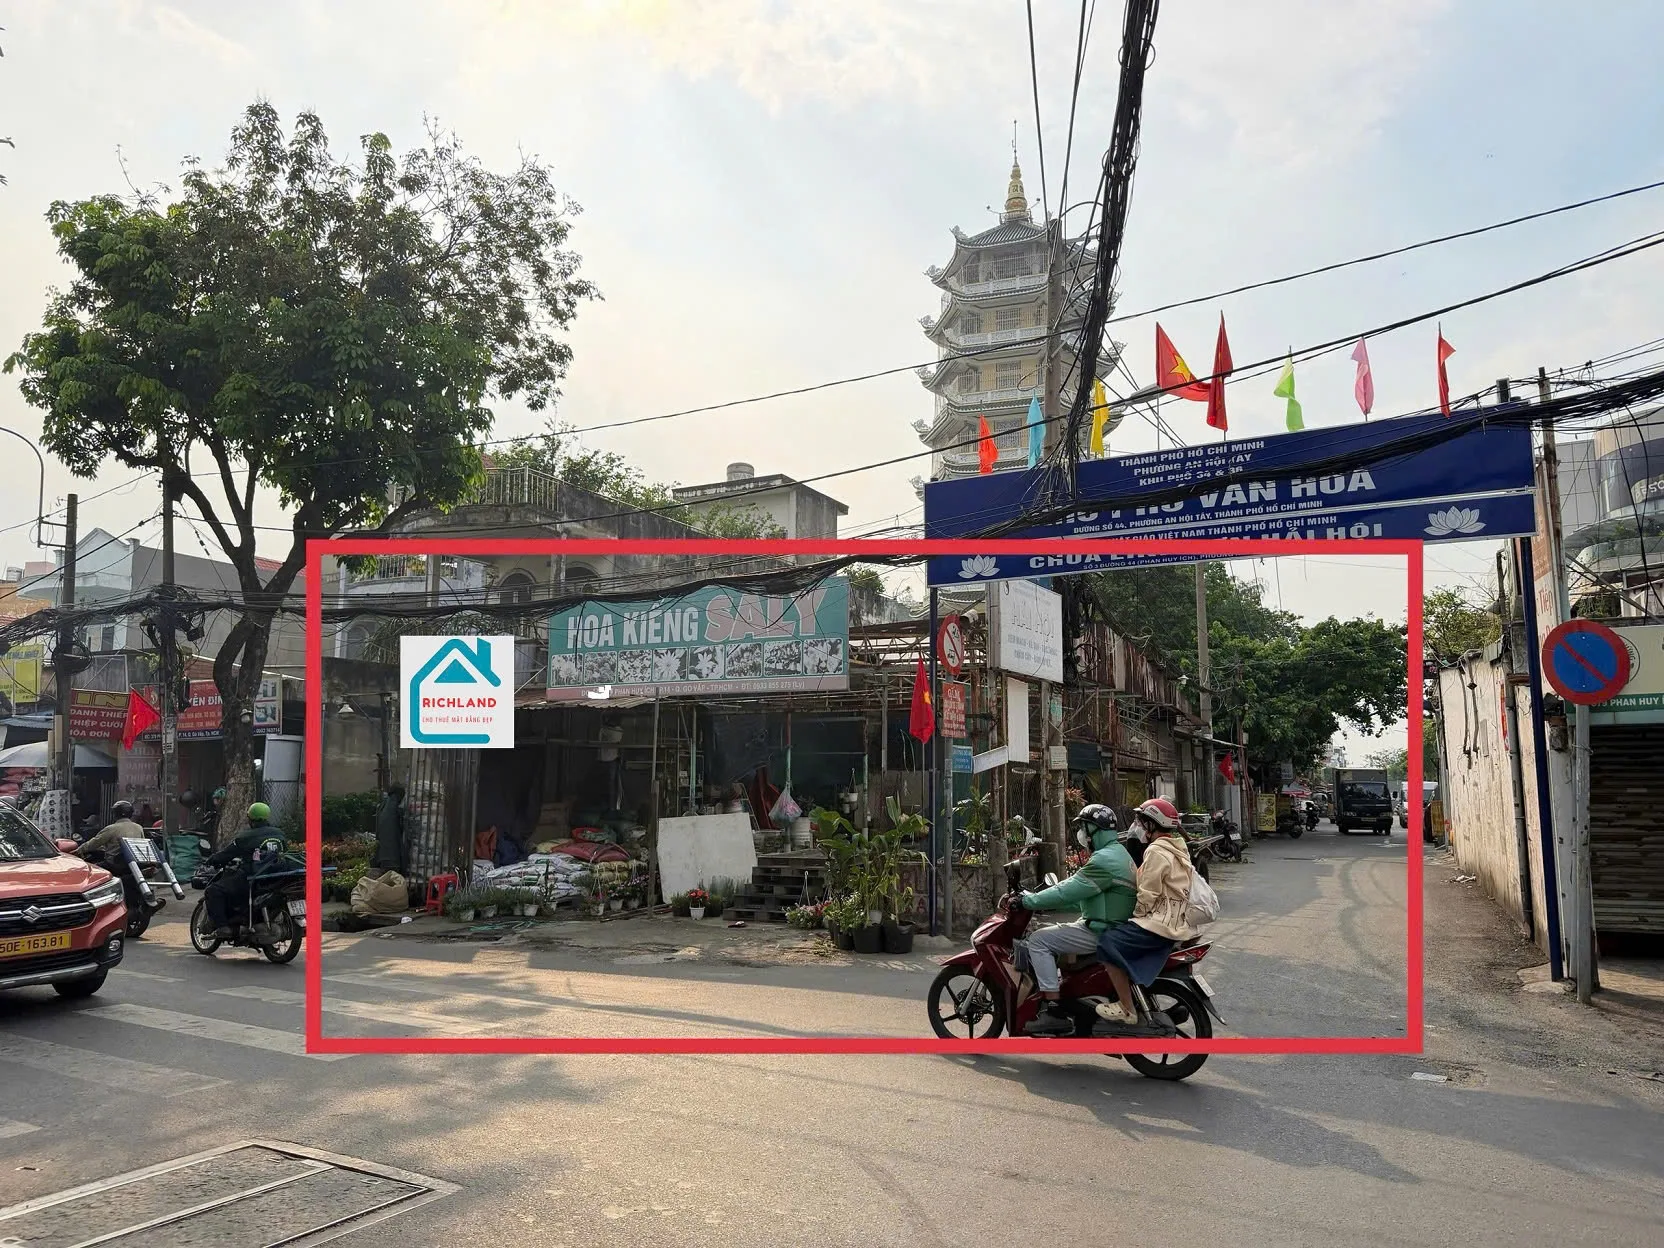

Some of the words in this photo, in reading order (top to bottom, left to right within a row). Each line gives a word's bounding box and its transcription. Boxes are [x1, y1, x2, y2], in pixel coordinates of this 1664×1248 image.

[1120, 456, 1157, 467] THÀNH
[1161, 449, 1184, 461] PHỐ
[1188, 447, 1204, 458] HỒ
[1207, 445, 1227, 455] CHÍ
[1231, 441, 1265, 452] MINH
[1130, 516, 1164, 528] PHƯỜNG
[1215, 508, 1243, 519] THÀNH
[1245, 504, 1264, 515] PHỐ
[1266, 503, 1279, 513] HỒ
[1281, 501, 1297, 511] CHÍ
[1298, 500, 1323, 509] MINH
[1182, 528, 1205, 539] NAM
[1208, 525, 1242, 536] THÀNH
[1245, 520, 1267, 532] PHỐ
[1269, 518, 1284, 530] HỒ
[1286, 516, 1305, 527] CHÍ
[1307, 515, 1337, 526] MINH
[567, 613, 615, 649] HOA
[622, 600, 699, 646] KIẾNG
[704, 588, 828, 643] SALY
[70, 708, 98, 718] DANH
[1610, 698, 1637, 707] PHAN
[1639, 697, 1660, 706] HUY
[0, 936, 64, 954] 50E-163.81
